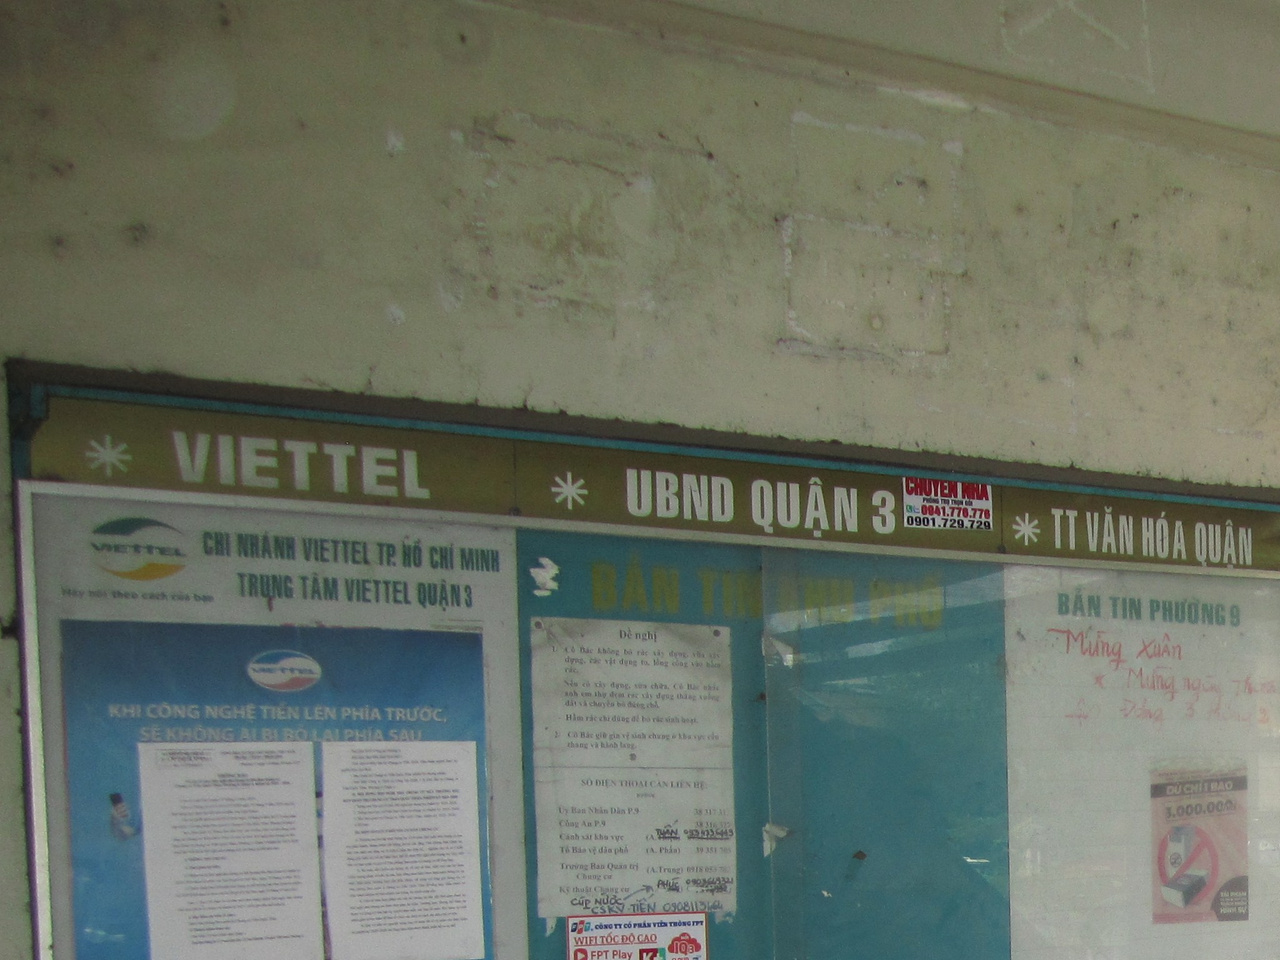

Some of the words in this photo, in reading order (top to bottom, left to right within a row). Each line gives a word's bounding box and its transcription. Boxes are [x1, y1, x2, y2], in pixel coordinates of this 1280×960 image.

[172, 430, 431, 500] VIETTEL
[625, 468, 734, 523] UBND
[751, 476, 858, 538] QUẬN
[871, 490, 896, 535] 3
[907, 516, 990, 530] 0901.729.729
[1051, 508, 1078, 550] TT
[1086, 506, 1133, 556] VĂN
[1141, 511, 1186, 560] HÓA
[1195, 520, 1252, 569] QUẬN
[91, 543, 187, 556] VIETTEL
[203, 531, 230, 556] CHI
[237, 530, 296, 560] NHÁNH
[303, 538, 370, 565] VIETTEL
[377, 542, 396, 566] TP.
[402, 535, 422, 567] HỒ
[429, 543, 453, 570] CHÍ
[459, 547, 499, 572] MINH
[237, 572, 294, 598] TRUNG
[300, 572, 339, 600] TÂM
[345, 578, 411, 605] VIETTEL
[417, 579, 460, 611] QUẬN
[465, 584, 473, 607] 3
[1109, 597, 1142, 620] TIN
[1229, 605, 1241, 627] 9
[635, 631, 657, 643] nghị
[250, 666, 318, 675] VIETTEL
[108, 703, 141, 717] KHI
[146, 701, 199, 719] CÔNG
[205, 701, 256, 722] NGHỆ
[303, 704, 336, 720] LÊN
[341, 703, 379, 721] PHÍA
[384, 705, 448, 723] TRƯỚC,
[165, 726, 234, 741] KHÔNG
[239, 728, 257, 741] AI
[388, 729, 421, 741] SAU
[581, 820, 592, 828] An
[574, 936, 598, 946] WIFI
[600, 932, 619, 944] TỐC
[621, 933, 636, 944] ĐỘ
[637, 934, 657, 943] CAO
[590, 950, 610, 960] FPT
